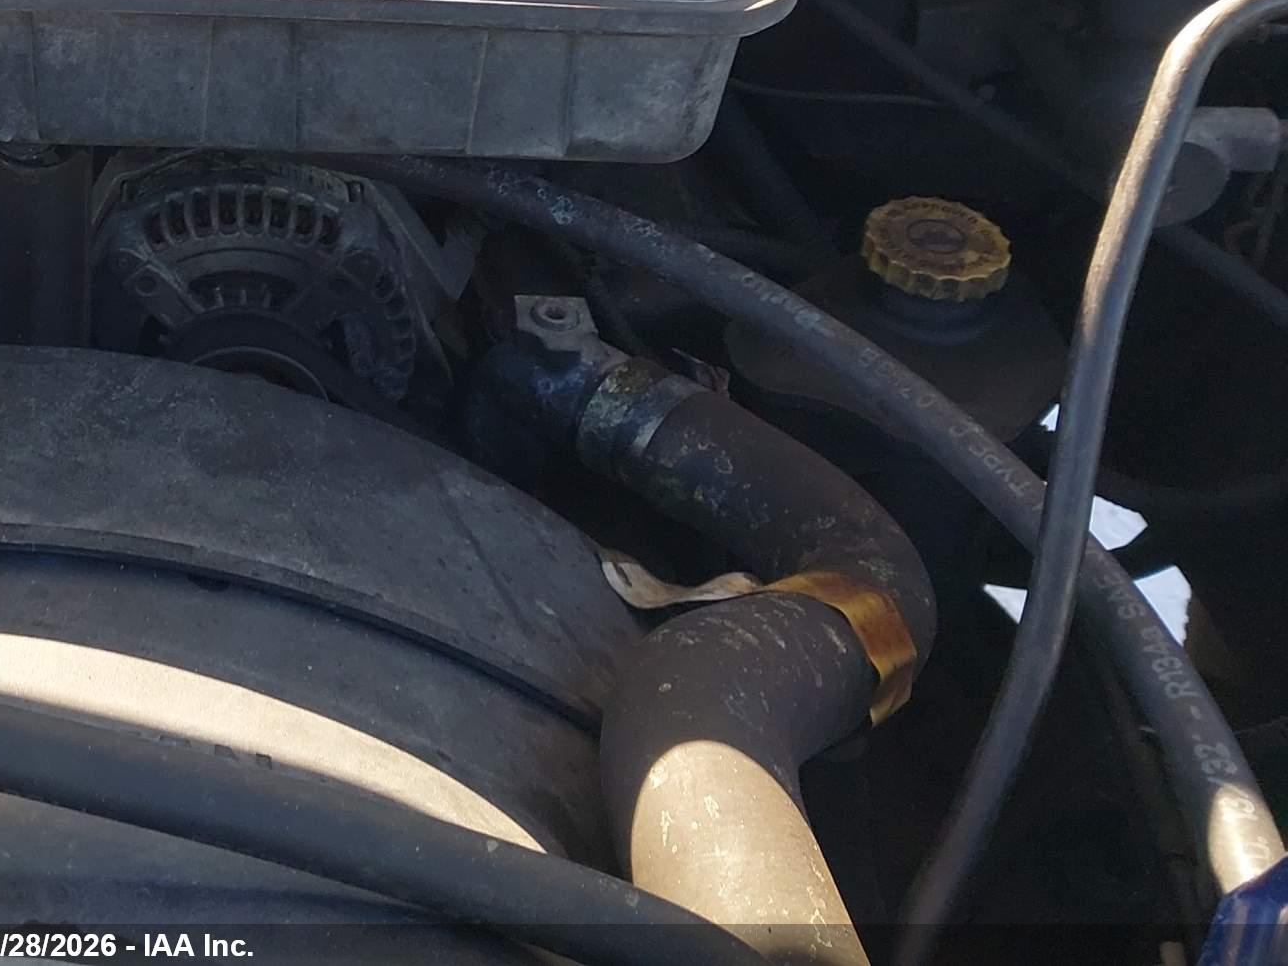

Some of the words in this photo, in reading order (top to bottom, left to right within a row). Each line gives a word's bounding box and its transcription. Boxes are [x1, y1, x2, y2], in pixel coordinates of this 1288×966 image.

[969, 437, 1031, 497] TYPE
[1095, 571, 1146, 620] SAE
[1142, 625, 1202, 700] R134a
